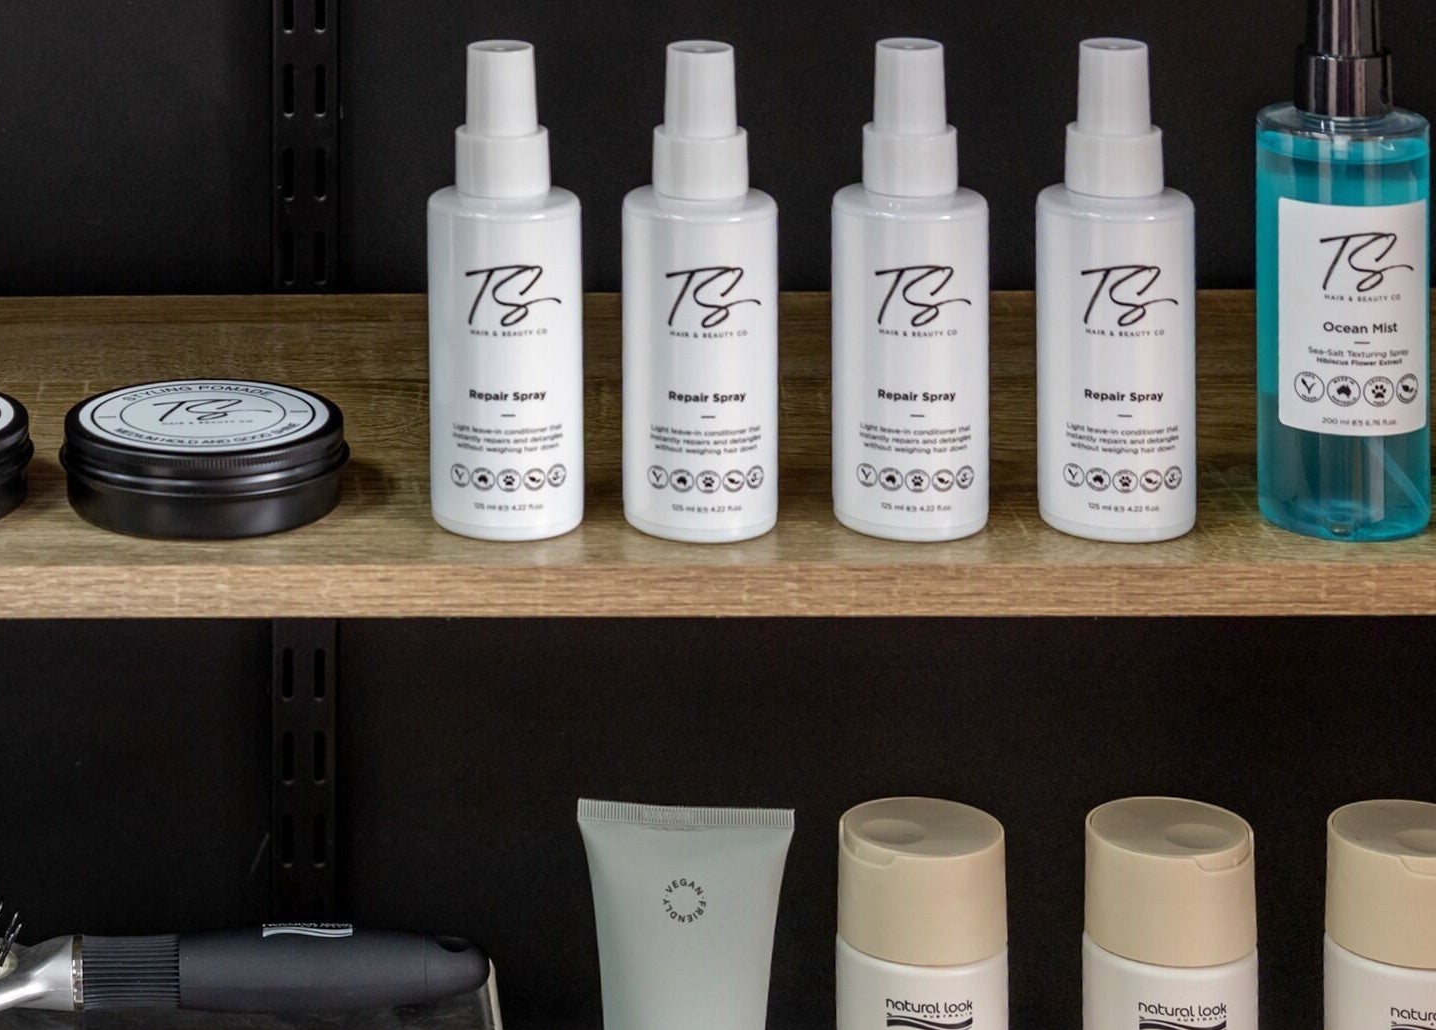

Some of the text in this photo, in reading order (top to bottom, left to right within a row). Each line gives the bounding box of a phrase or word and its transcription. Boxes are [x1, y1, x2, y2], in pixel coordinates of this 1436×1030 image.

[1324, 294, 1344, 302] HAIR
[1323, 321, 1398, 334] Ocean Mist
[1347, 350, 1387, 360] Texturing
[122, 384, 276, 401] STYLING POMADE
[469, 389, 547, 403] Repair Spray
[668, 390, 746, 404] Repair Spray
[877, 388, 956, 402] Repair Spray
[1084, 388, 1163, 403] Repair Spray
[1322, 417, 1338, 425] 200
[662, 878, 707, 923] VEGAN FRIENDLY
[886, 998, 973, 1014] natural look
[1138, 1002, 1227, 1017] natural look
